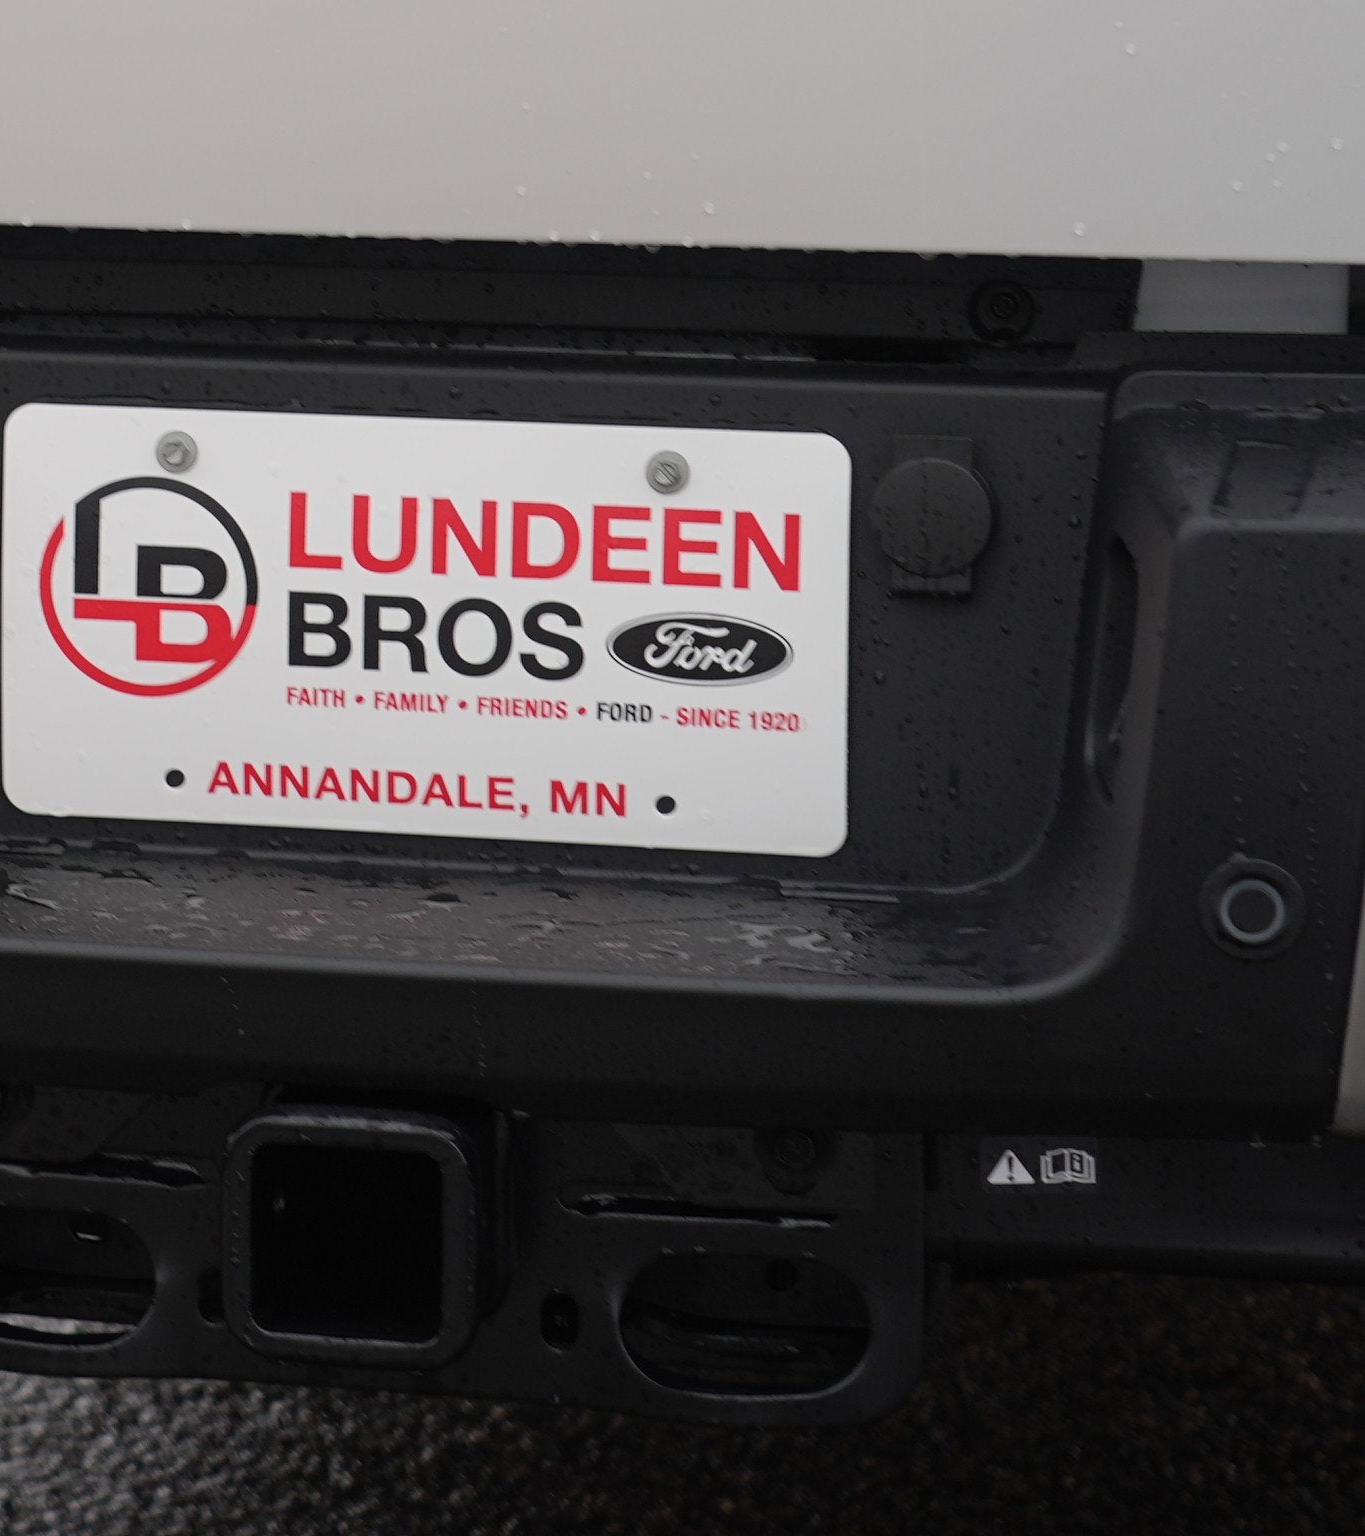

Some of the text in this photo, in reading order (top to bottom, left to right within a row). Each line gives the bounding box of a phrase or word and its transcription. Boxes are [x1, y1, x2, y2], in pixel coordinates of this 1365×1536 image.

[288, 491, 802, 593] LUNDEEN
[288, 591, 585, 681] BROS
[643, 621, 759, 674] Ford
[287, 687, 801, 732] FAITH FAMILY FRIENDS FORD SINCE 1920
[207, 761, 627, 818] ANNANDALE, MN
